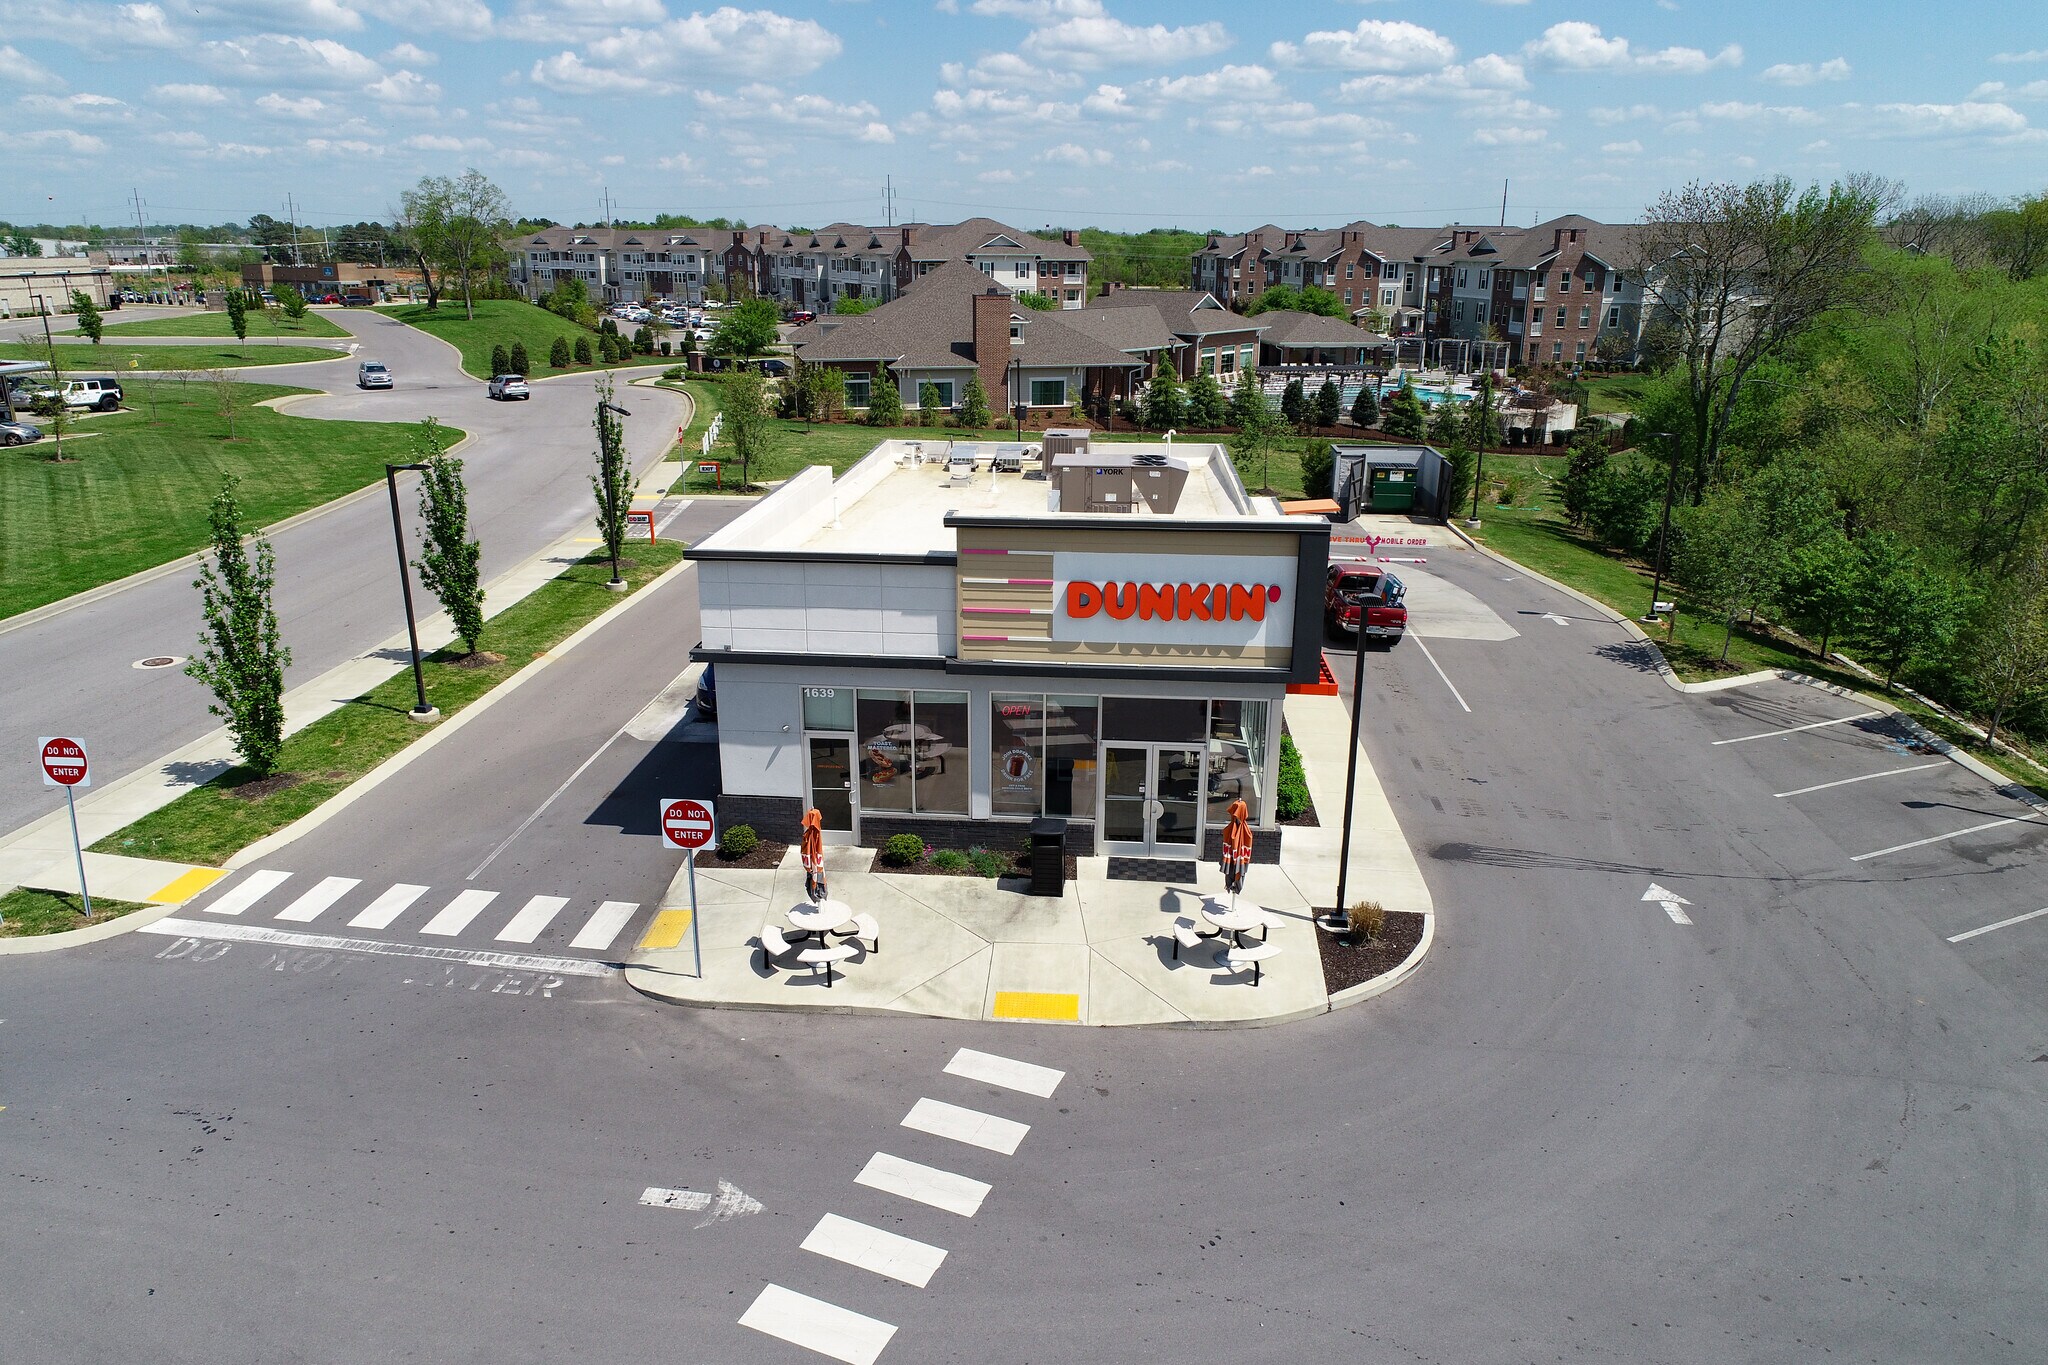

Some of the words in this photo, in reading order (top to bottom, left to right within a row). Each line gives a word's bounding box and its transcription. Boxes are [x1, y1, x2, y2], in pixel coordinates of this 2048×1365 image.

[1381, 537, 1403, 545] MOBILE
[1407, 538, 1427, 546] ORDER
[1067, 581, 1282, 622] DUNKIN'
[804, 688, 835, 698] 1639
[1002, 705, 1031, 716] OPEN
[47, 747, 59, 755] DO
[63, 747, 79, 755] NOT
[53, 767, 80, 776] ENTER
[670, 809, 683, 818] DO
[687, 810, 706, 818] NOT
[674, 830, 704, 840] ENTER
[155, 937, 233, 963] DO
